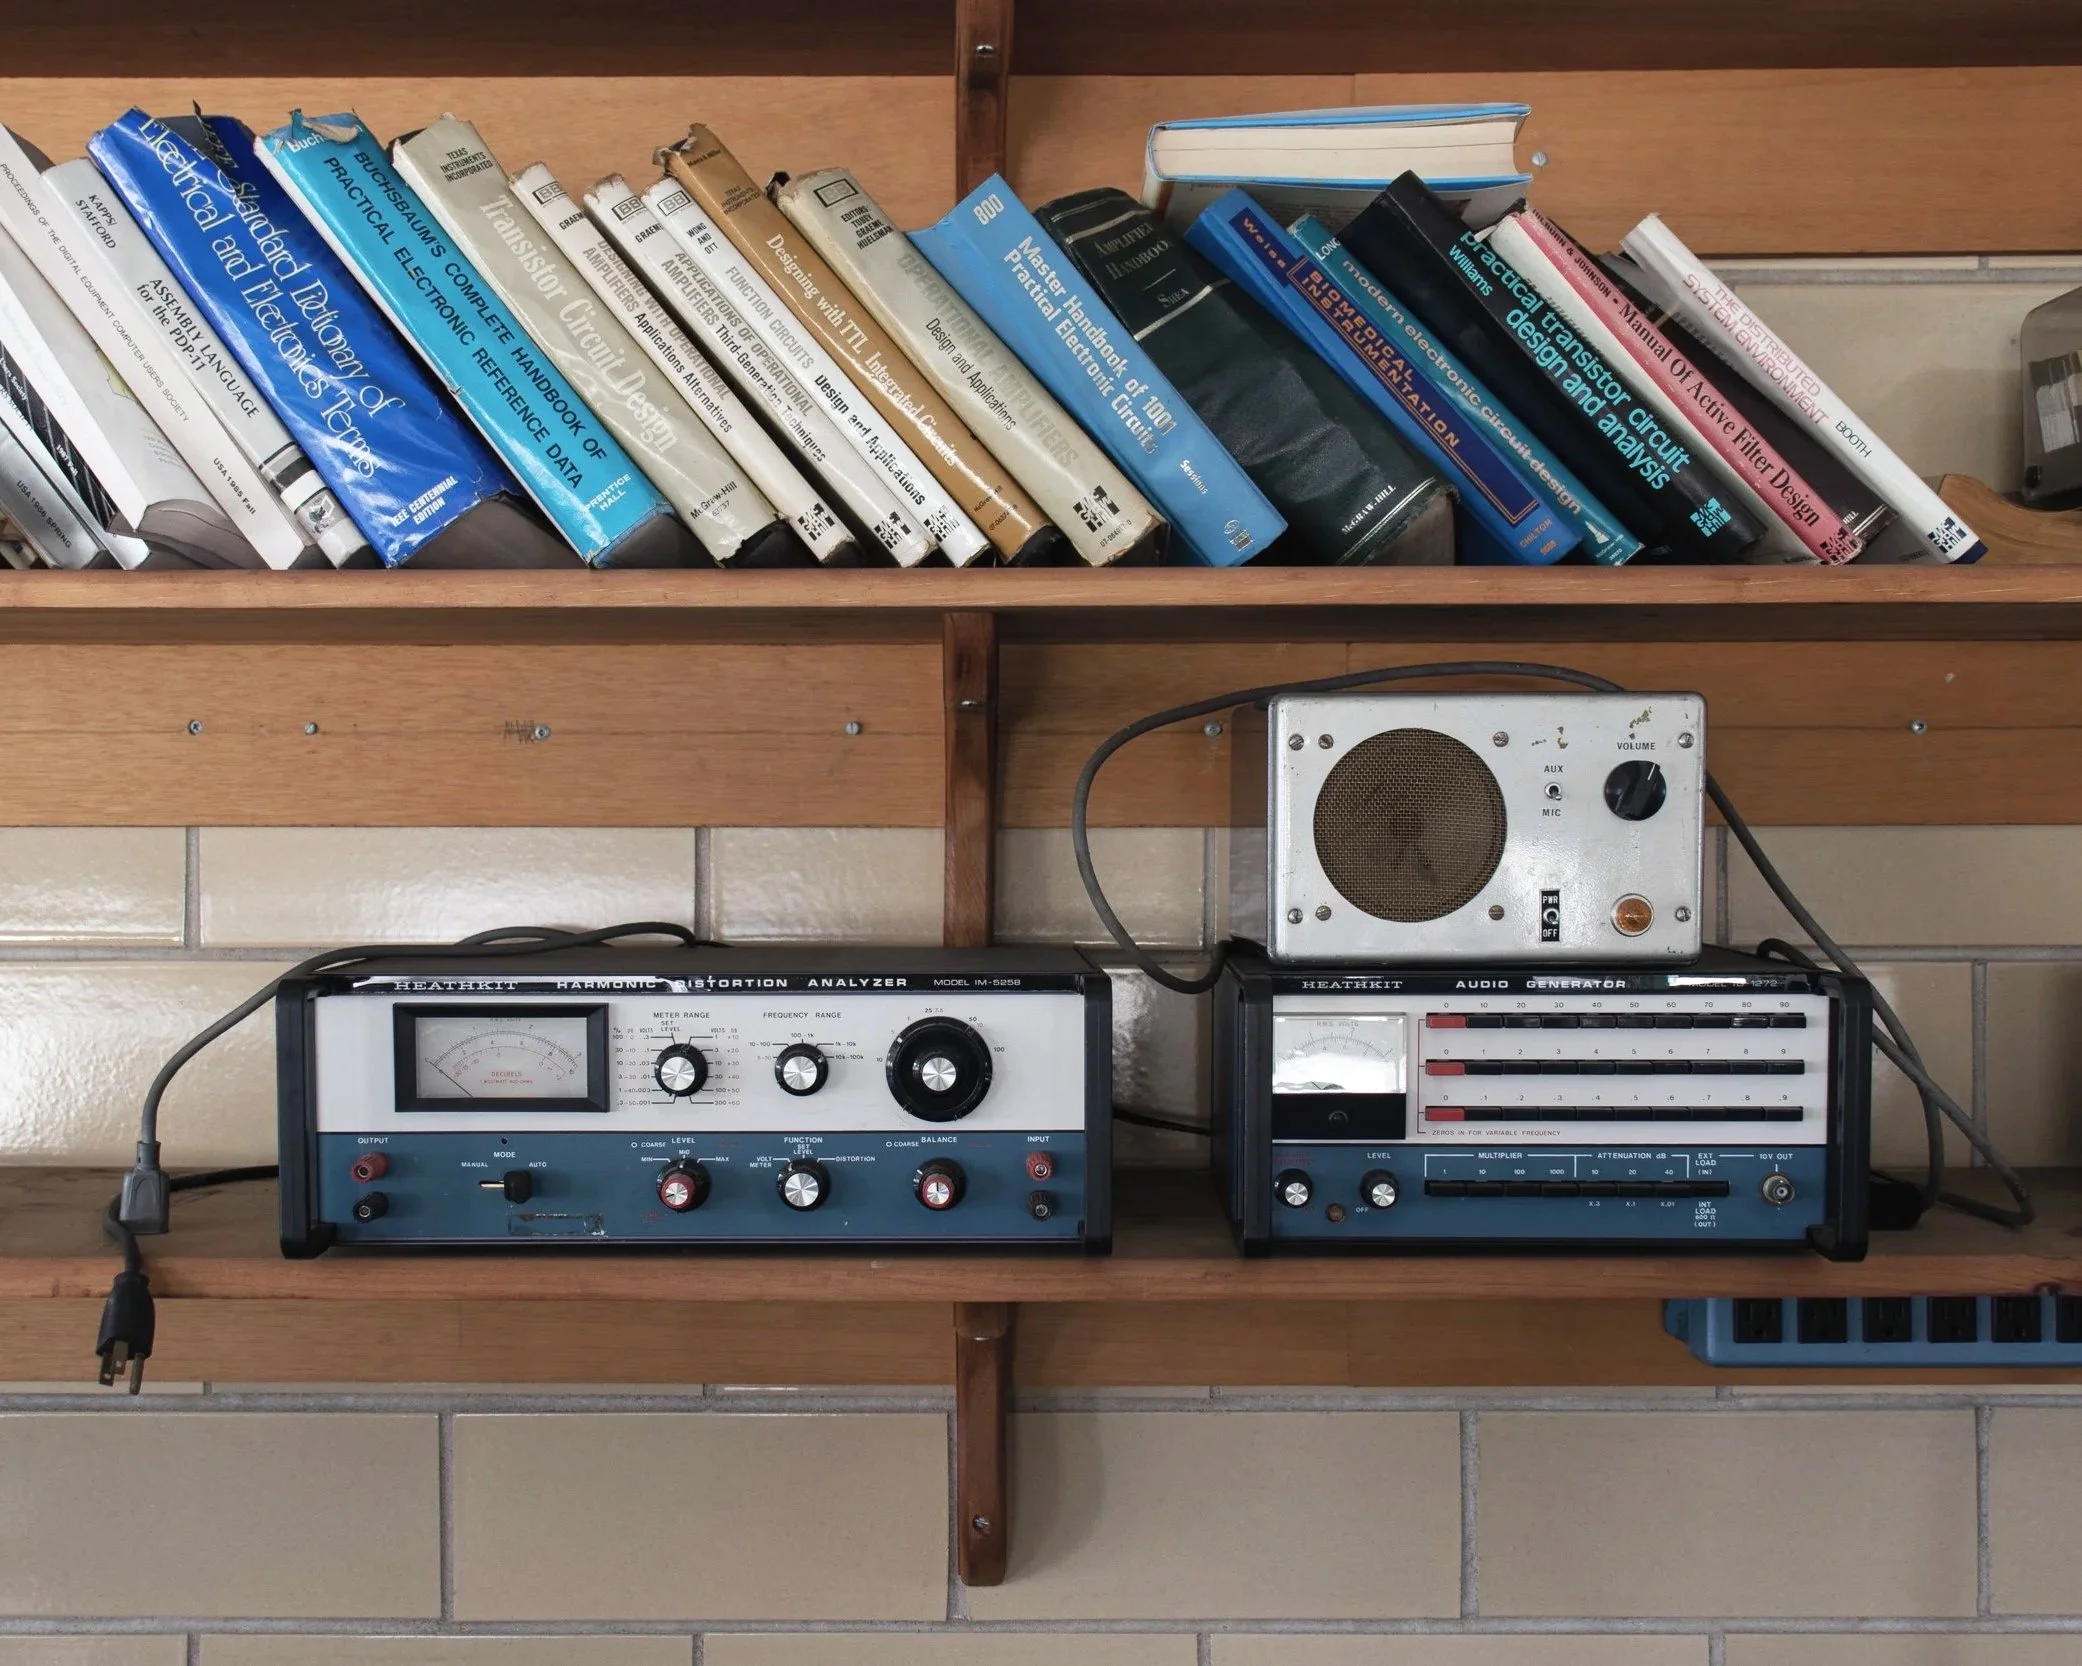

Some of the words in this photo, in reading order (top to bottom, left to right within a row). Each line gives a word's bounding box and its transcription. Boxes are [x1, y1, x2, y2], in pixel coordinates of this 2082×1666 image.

[440, 151, 487, 174] INSTRUMENTS
[445, 159, 494, 183] INCORPORATED
[446, 147, 469, 161] TEXAS
[75, 199, 116, 249] STAFFORD
[88, 194, 117, 227] KAPPS/
[687, 222, 707, 238] WONG
[851, 214, 873, 228] TOBEY
[855, 220, 884, 238] GRAEME
[973, 194, 1004, 225] 800
[698, 233, 712, 245] AND
[705, 242, 718, 254] OTT
[857, 225, 894, 249] HUELSMAN
[1, 163, 40, 216] PROCEEDINGS
[38, 216, 50, 228] OF
[48, 228, 61, 247] THE
[59, 245, 81, 276] DIGITAL
[80, 276, 114, 319] EQUIPMENT
[112, 320, 144, 361] COMPUTER
[143, 361, 164, 388] USERS
[163, 388, 190, 422] SOCIETY
[1449, 244, 1493, 297] Williams
[138, 118, 237, 233] Electrical
[211, 233, 266, 282] and
[242, 278, 331, 399] Electronics
[320, 389, 381, 478] Terms
[323, 156, 396, 245] PRACTICAL
[393, 247, 476, 346] ELECTRONIC
[472, 347, 550, 443] REFERENCE
[545, 443, 584, 488] DATA
[353, 151, 447, 258] BUCHSBAUM'S
[444, 262, 515, 344] COMPLETE
[511, 347, 586, 437] HANDBOOK
[582, 438, 607, 460] OF
[479, 194, 568, 300] Transistor
[559, 298, 628, 380] Circuit
[615, 369, 678, 454] Design
[597, 240, 646, 297] DESIGNING
[645, 297, 671, 327] WITH
[669, 324, 731, 400] OPERATIONAL
[1018, 235, 1067, 297] Master
[1062, 294, 1128, 378] Handbook
[1124, 378, 1149, 398] of
[136, 283, 153, 303] for
[152, 304, 171, 327] the
[169, 321, 208, 372] PDP-11
[149, 278, 203, 342] ASSEMBLY
[200, 344, 259, 419] LANGUAGE
[290, 278, 370, 381] Dictionary
[359, 386, 406, 418] of
[583, 247, 640, 312] AMPLIFIERS
[635, 312, 685, 374] Applications
[683, 372, 732, 433] Alternatives
[675, 252, 741, 326] APPLICATIONS
[738, 326, 755, 342] OF
[751, 342, 813, 416] OPERATIONAL
[766, 234, 820, 298] Designing
[817, 296, 846, 327] with
[840, 319, 869, 354] TTL
[865, 352, 925, 416] Integrated
[1003, 249, 1062, 322] Practical
[1055, 317, 1115, 397] Electronic
[1111, 393, 1159, 454] Circuits
[1309, 271, 1413, 381] BIOMEDICAL
[1683, 273, 1739, 333] SYSTEM
[1735, 328, 1830, 425] ENVIRONMENT
[1715, 286, 1741, 316] THE
[1739, 312, 1821, 397] DISTRIBUTED
[661, 259, 719, 325] AMPLIFIERS
[716, 324, 782, 406] Third-Generation
[780, 405, 826, 462] Techniques
[897, 253, 993, 364] OPERATIONAL
[989, 364, 1078, 467] AMPLIFIERS
[926, 318, 956, 355] Design
[952, 352, 975, 374] and
[967, 372, 1017, 431] Applications
[1302, 277, 1460, 448] INSTRUMENTATION
[1460, 230, 1544, 314] practical
[1541, 311, 1632, 406] transistor
[1628, 407, 1691, 474] circuit
[725, 266, 774, 320] FUNCTION
[769, 318, 814, 369] CIRCUITS
[814, 374, 850, 414] Design
[848, 414, 872, 436] and
[866, 436, 925, 505] Applications
[1342, 260, 1405, 324] modern
[1405, 324, 1479, 406] electronic
[1480, 406, 1532, 460] circuit
[1530, 459, 1581, 515] design
[1506, 308, 1569, 379] design
[1562, 373, 1607, 417] and
[1597, 412, 1671, 490] analysis
[1566, 248, 1574, 257] &
[1574, 256, 1612, 299] JOHNSON
[1619, 303, 1673, 363] Manual
[1670, 358, 1694, 384] Of
[1688, 381, 1735, 434] Active
[1732, 425, 1774, 475] Filter
[1769, 468, 1822, 527] Design
[1835, 420, 1873, 459] BOOTH
[213, 457, 227, 476] USA
[227, 476, 243, 498] 1985
[242, 496, 257, 515] Fall
[391, 509, 410, 528] IEEE
[408, 475, 458, 514] CENTENNIAL
[584, 473, 632, 511] PRENTICE
[599, 489, 627, 512] HALL
[690, 480, 738, 520] McGraw-Hill
[1180, 459, 1209, 495] Sessions
[16, 480, 31, 499] USA
[47, 516, 72, 549] SPRING
[413, 497, 446, 525] EDITION
[1341, 485, 1397, 535] McGRAW-HILL
[1520, 518, 1553, 548] CHILTON
[1544, 765, 1564, 773] AUX
[1617, 742, 1656, 750] VOLUME
[1542, 809, 1561, 817] MIC
[1542, 896, 1558, 904] PWR
[1542, 929, 1557, 938] OFF
[394, 981, 518, 991] HEATHKIT
[557, 980, 656, 989] HARMONIC
[676, 978, 788, 989] DISTORTION
[808, 978, 907, 987] ANALYZER
[1302, 981, 1403, 989] HEATHKIT
[1456, 980, 1509, 988] AUDIO
[1526, 980, 1626, 988] GENERATOR
